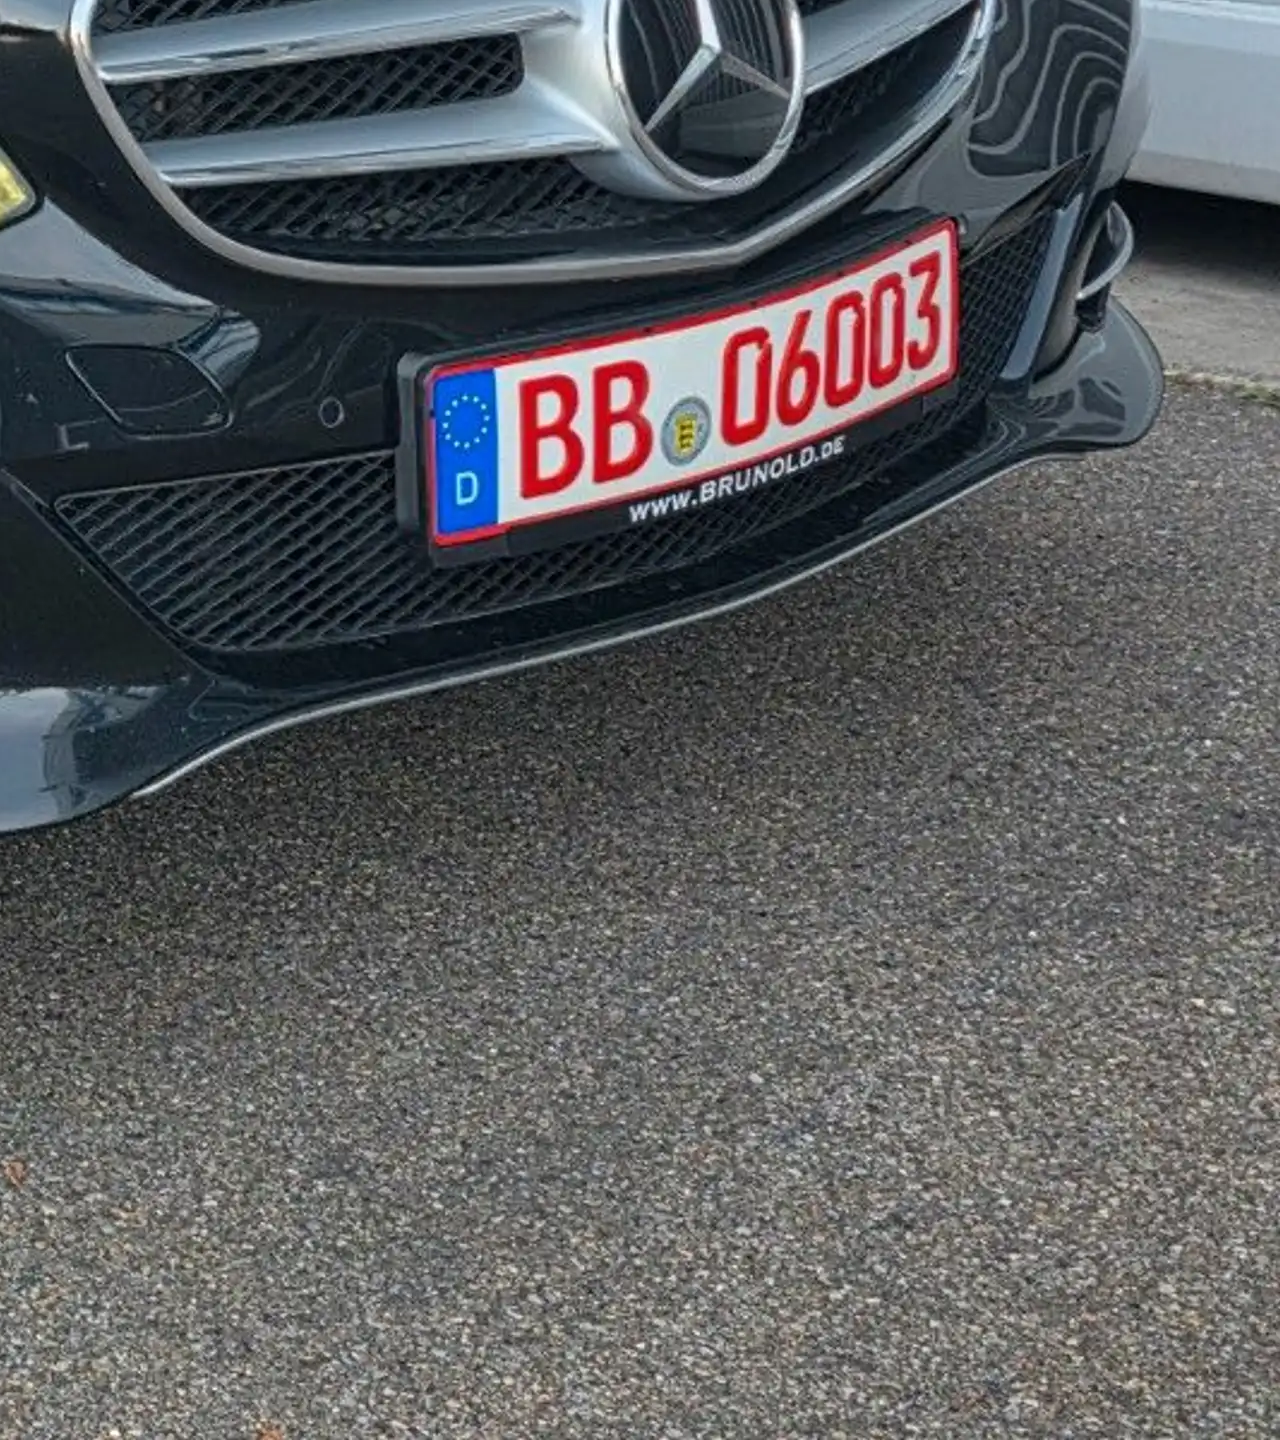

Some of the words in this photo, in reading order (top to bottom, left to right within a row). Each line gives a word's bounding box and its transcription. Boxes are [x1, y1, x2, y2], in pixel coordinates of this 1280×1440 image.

[518, 359, 653, 499] BB
[720, 251, 942, 446] 06003
[455, 471, 478, 505] D
